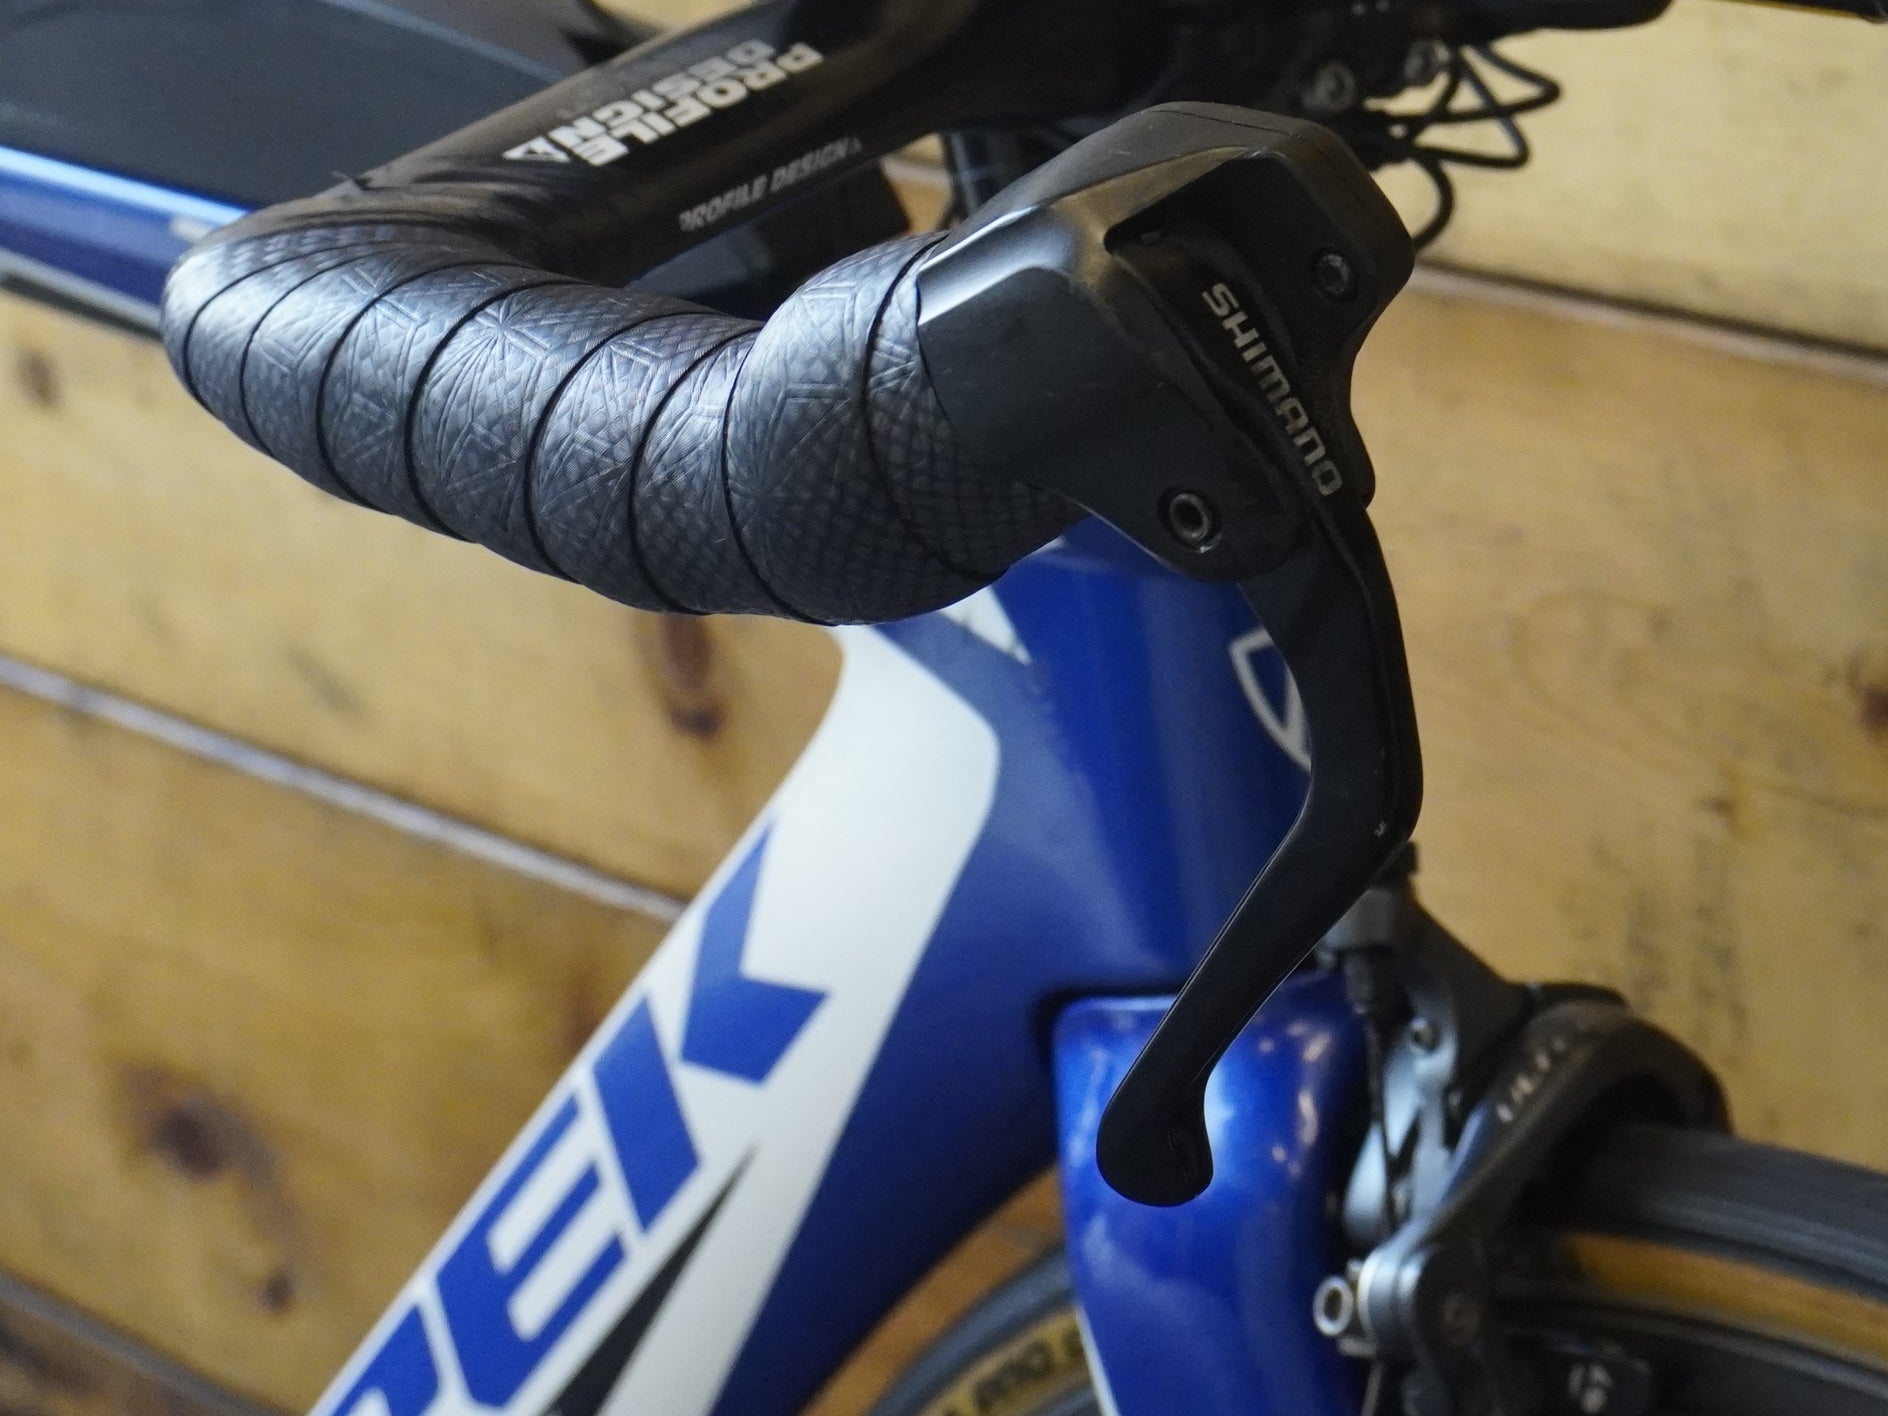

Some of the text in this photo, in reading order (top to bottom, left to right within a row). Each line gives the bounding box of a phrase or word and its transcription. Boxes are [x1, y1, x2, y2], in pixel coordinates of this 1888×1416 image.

[549, 40, 775, 148] DESIGN
[575, 43, 825, 166] PROFILE
[1201, 283, 1343, 496] SHIMANO
